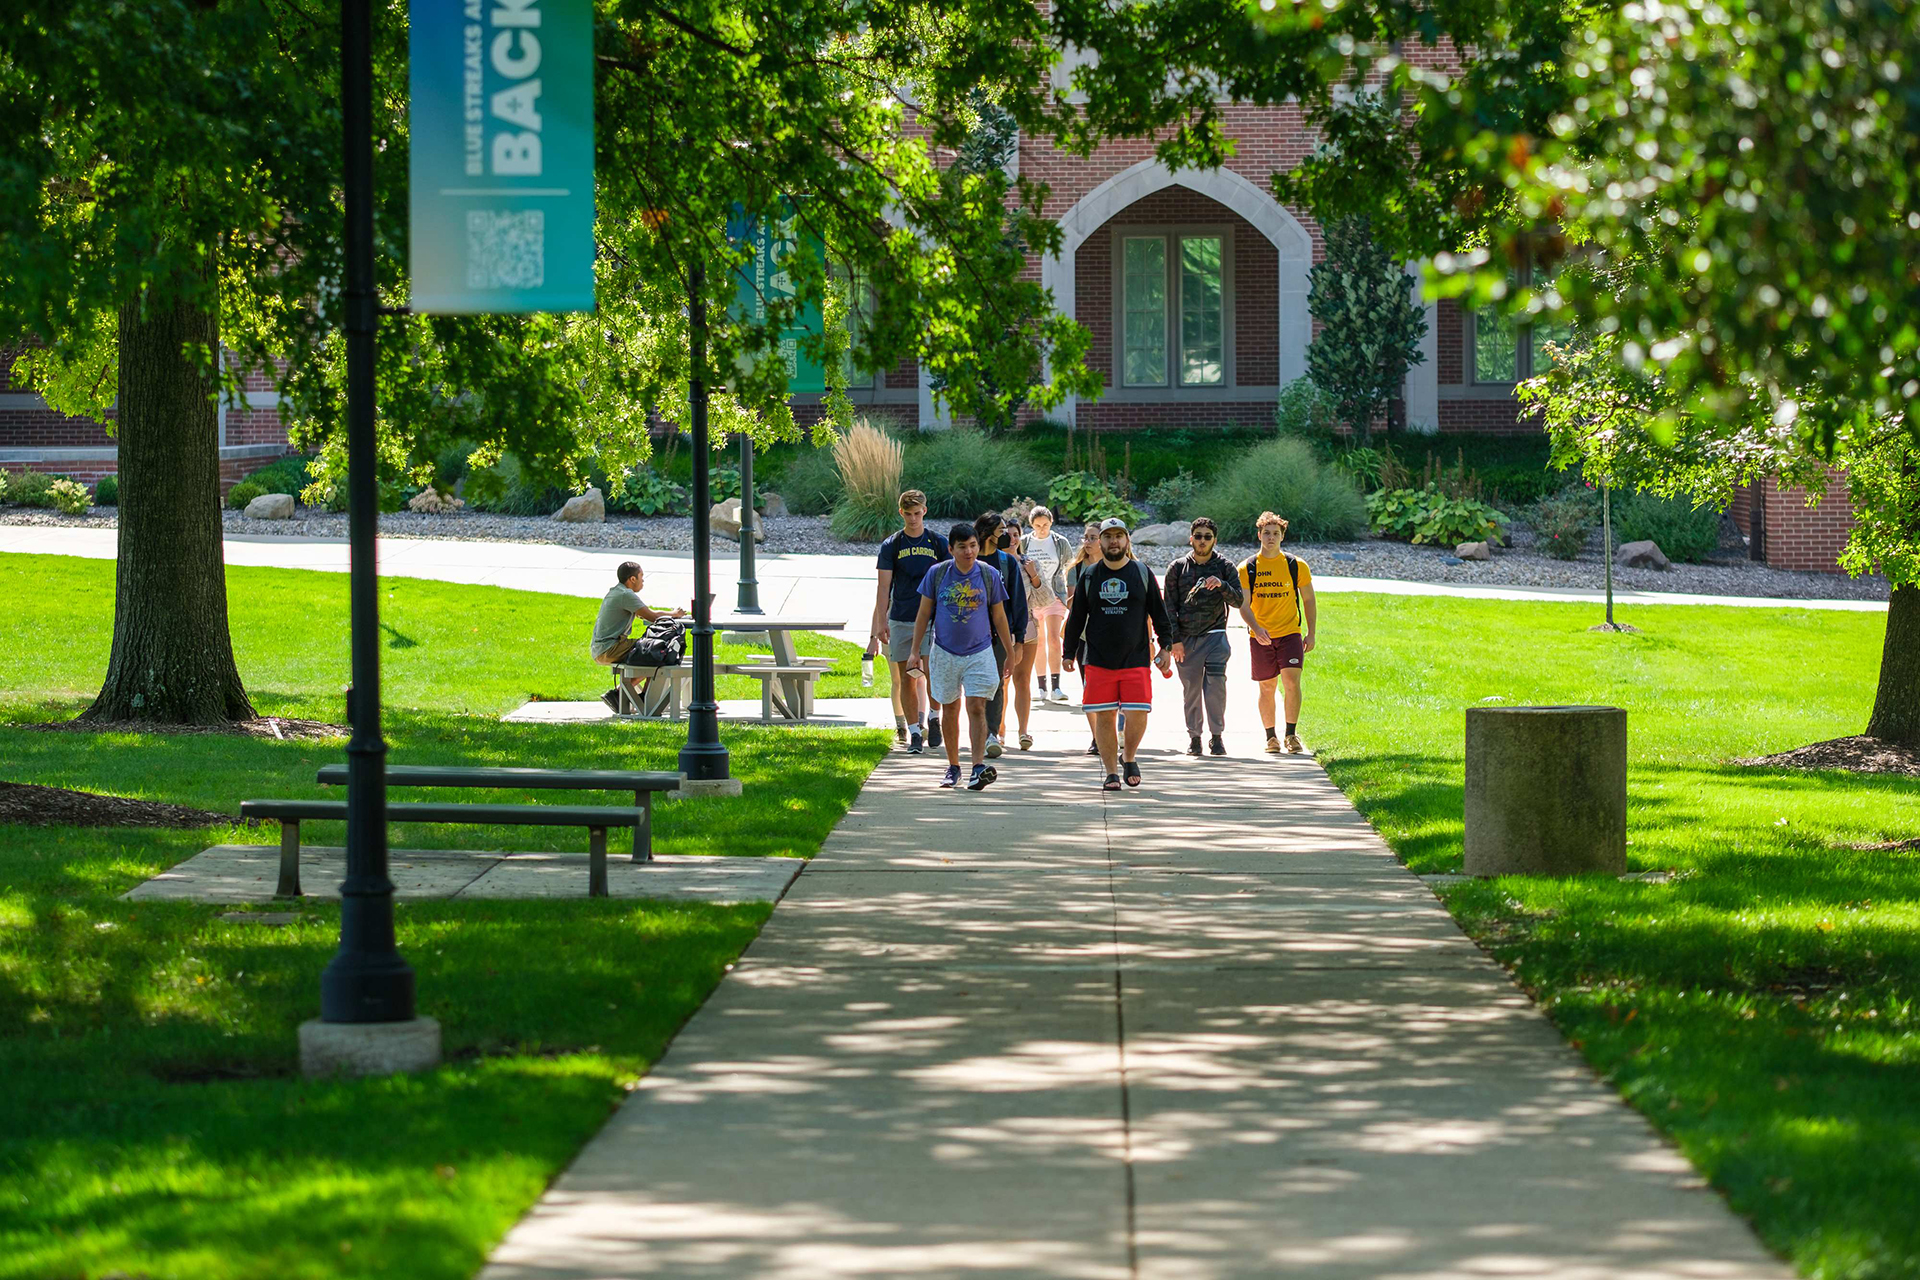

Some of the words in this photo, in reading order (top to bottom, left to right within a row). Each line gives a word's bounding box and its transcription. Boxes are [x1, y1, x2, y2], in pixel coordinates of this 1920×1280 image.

[463, 24, 483, 120] STREAKS
[464, 123, 483, 176] BLUE
[756, 238, 765, 290] STREAKS
